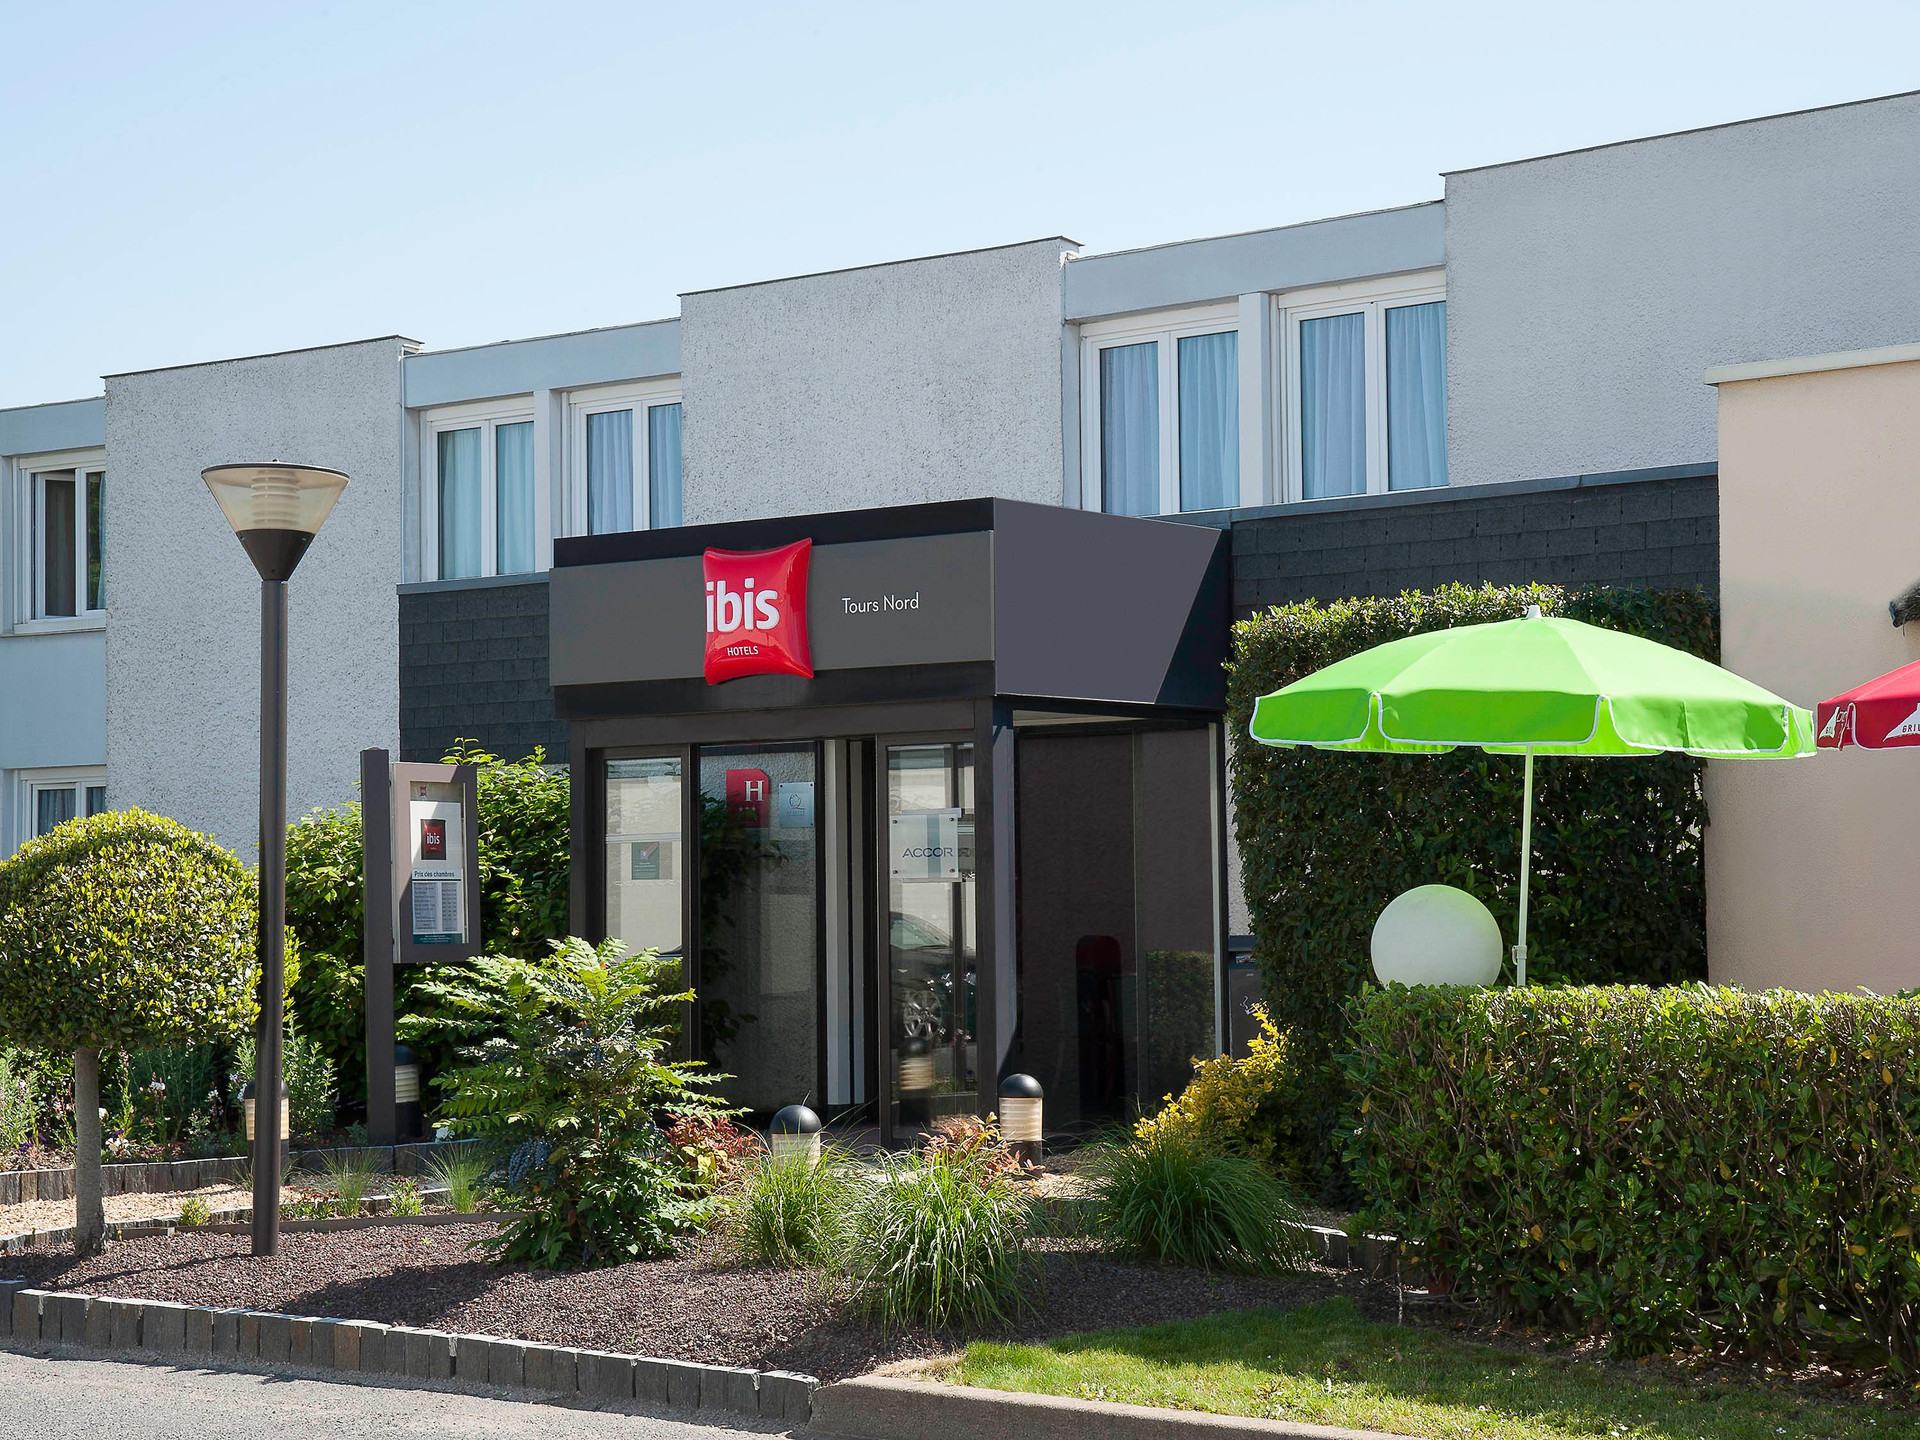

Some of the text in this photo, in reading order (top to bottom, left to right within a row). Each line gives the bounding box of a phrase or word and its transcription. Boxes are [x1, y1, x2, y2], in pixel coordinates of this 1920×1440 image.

[706, 577, 780, 633] ibis
[842, 592, 918, 614] Tours Nord
[727, 646, 759, 656] HOTELS
[744, 780, 764, 802] H
[426, 832, 441, 844] ibis
[902, 847, 953, 858] ACCOR
